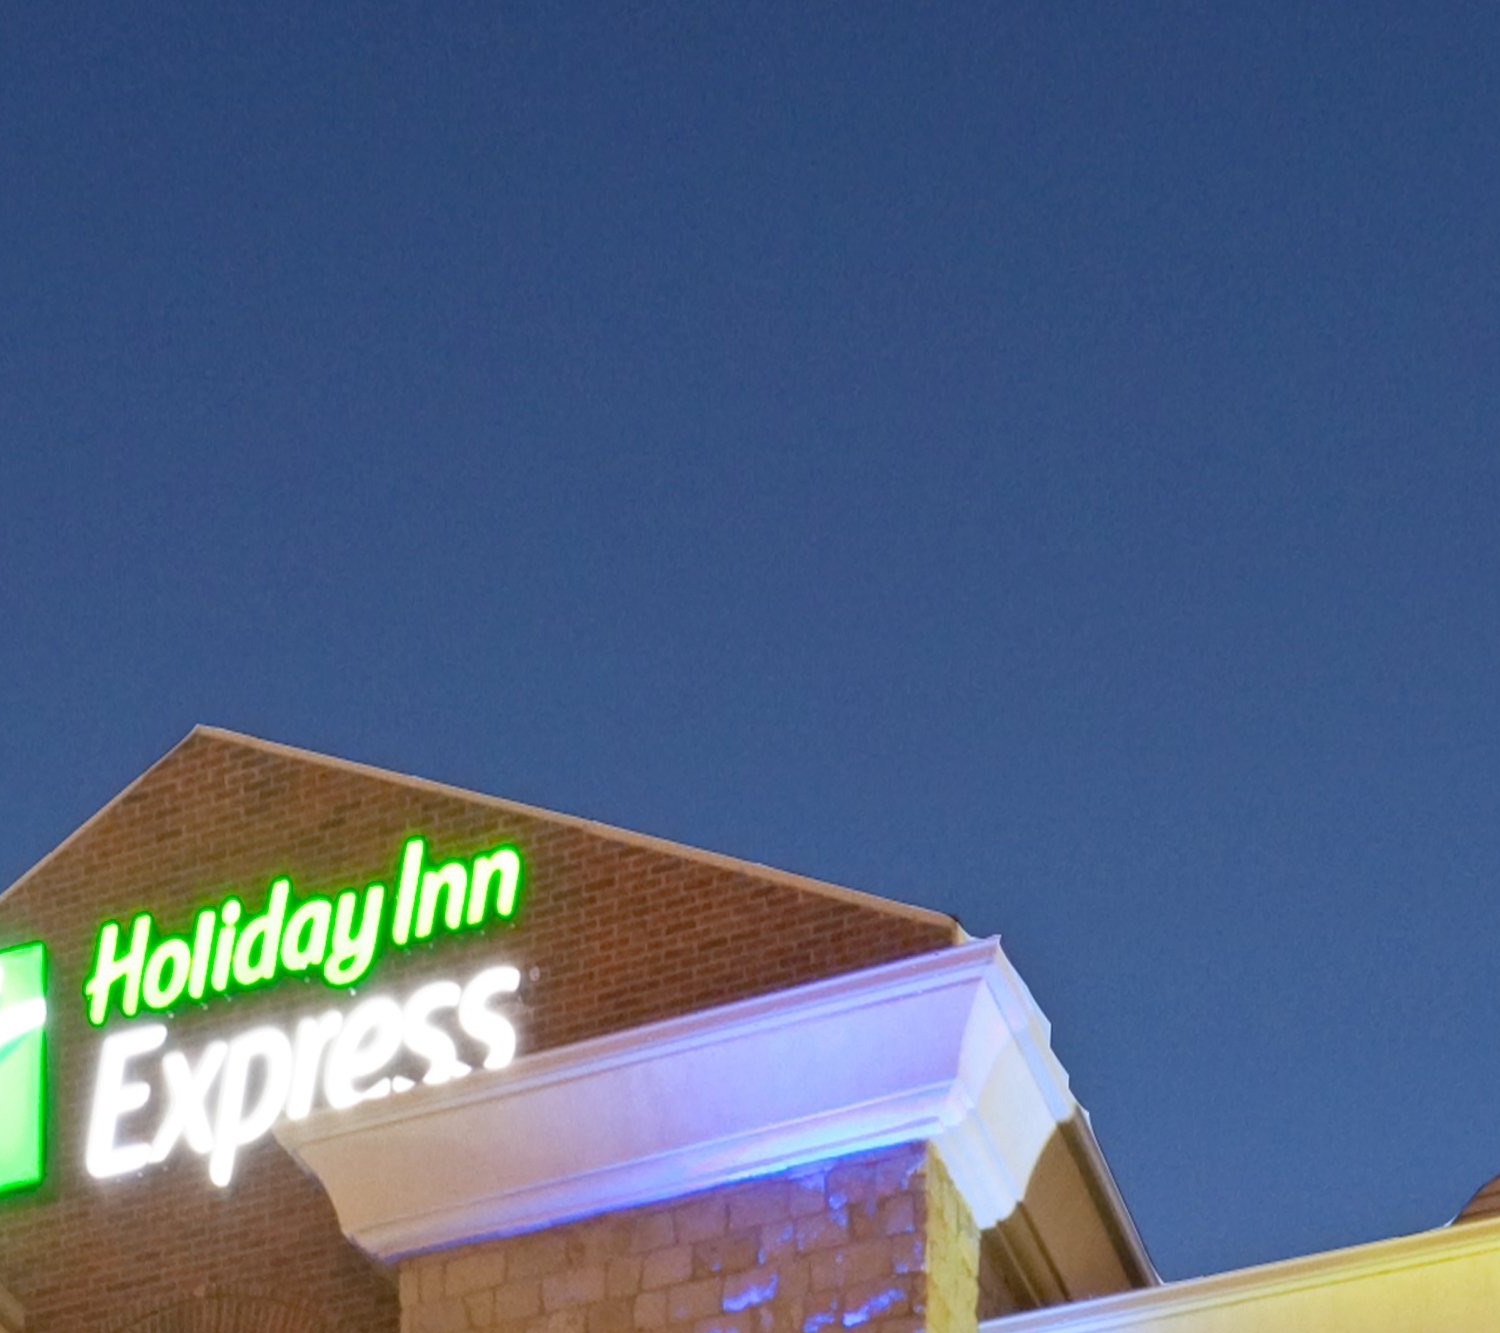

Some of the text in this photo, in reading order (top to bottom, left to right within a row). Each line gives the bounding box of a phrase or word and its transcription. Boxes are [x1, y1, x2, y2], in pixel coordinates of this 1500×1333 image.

[85, 835, 522, 1027] Holiday Inn
[84, 964, 522, 1188] Express
